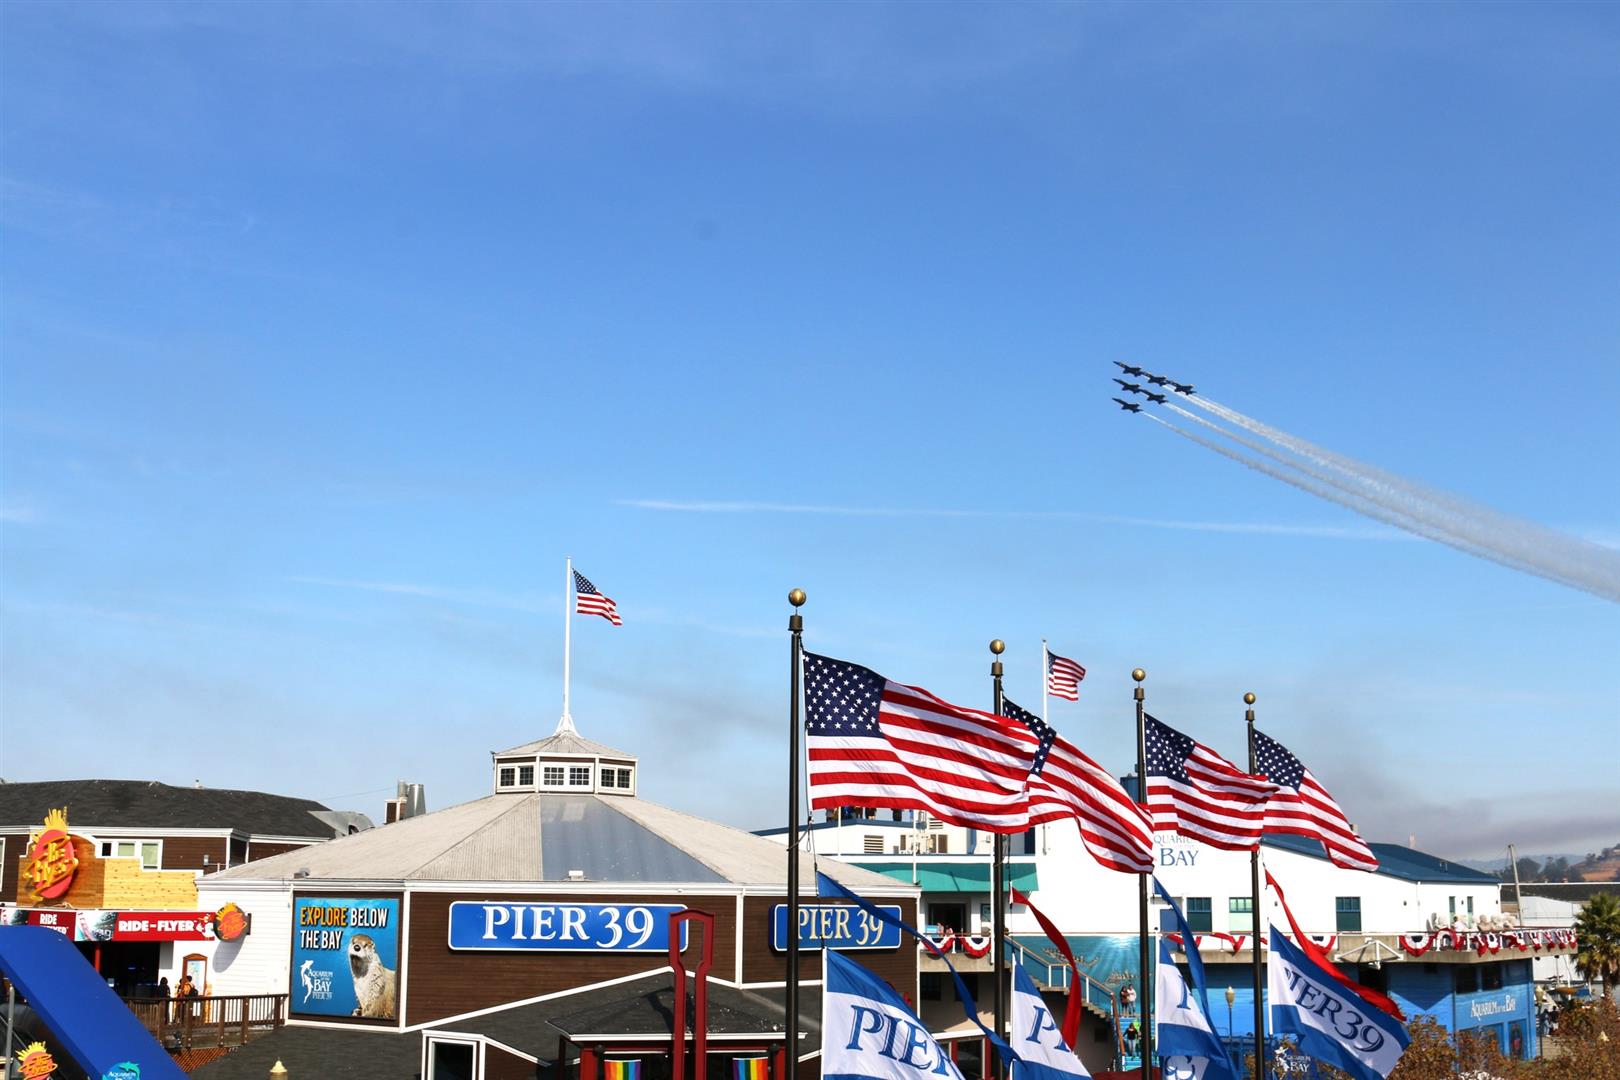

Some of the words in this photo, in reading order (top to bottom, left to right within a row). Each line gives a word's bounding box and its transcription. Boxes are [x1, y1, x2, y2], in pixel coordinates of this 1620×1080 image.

[1160, 847, 1199, 866] BAY
[39, 913, 58, 925] RIDE
[301, 907, 347, 926] EXPLORE
[351, 908, 388, 927] BELOW
[798, 908, 852, 940] PIER
[856, 909, 884, 946] 39
[482, 906, 590, 940] PIER
[596, 907, 654, 949] 39
[300, 930, 319, 948] THE
[321, 931, 342, 950] BAY
[313, 978, 332, 992] BAY
